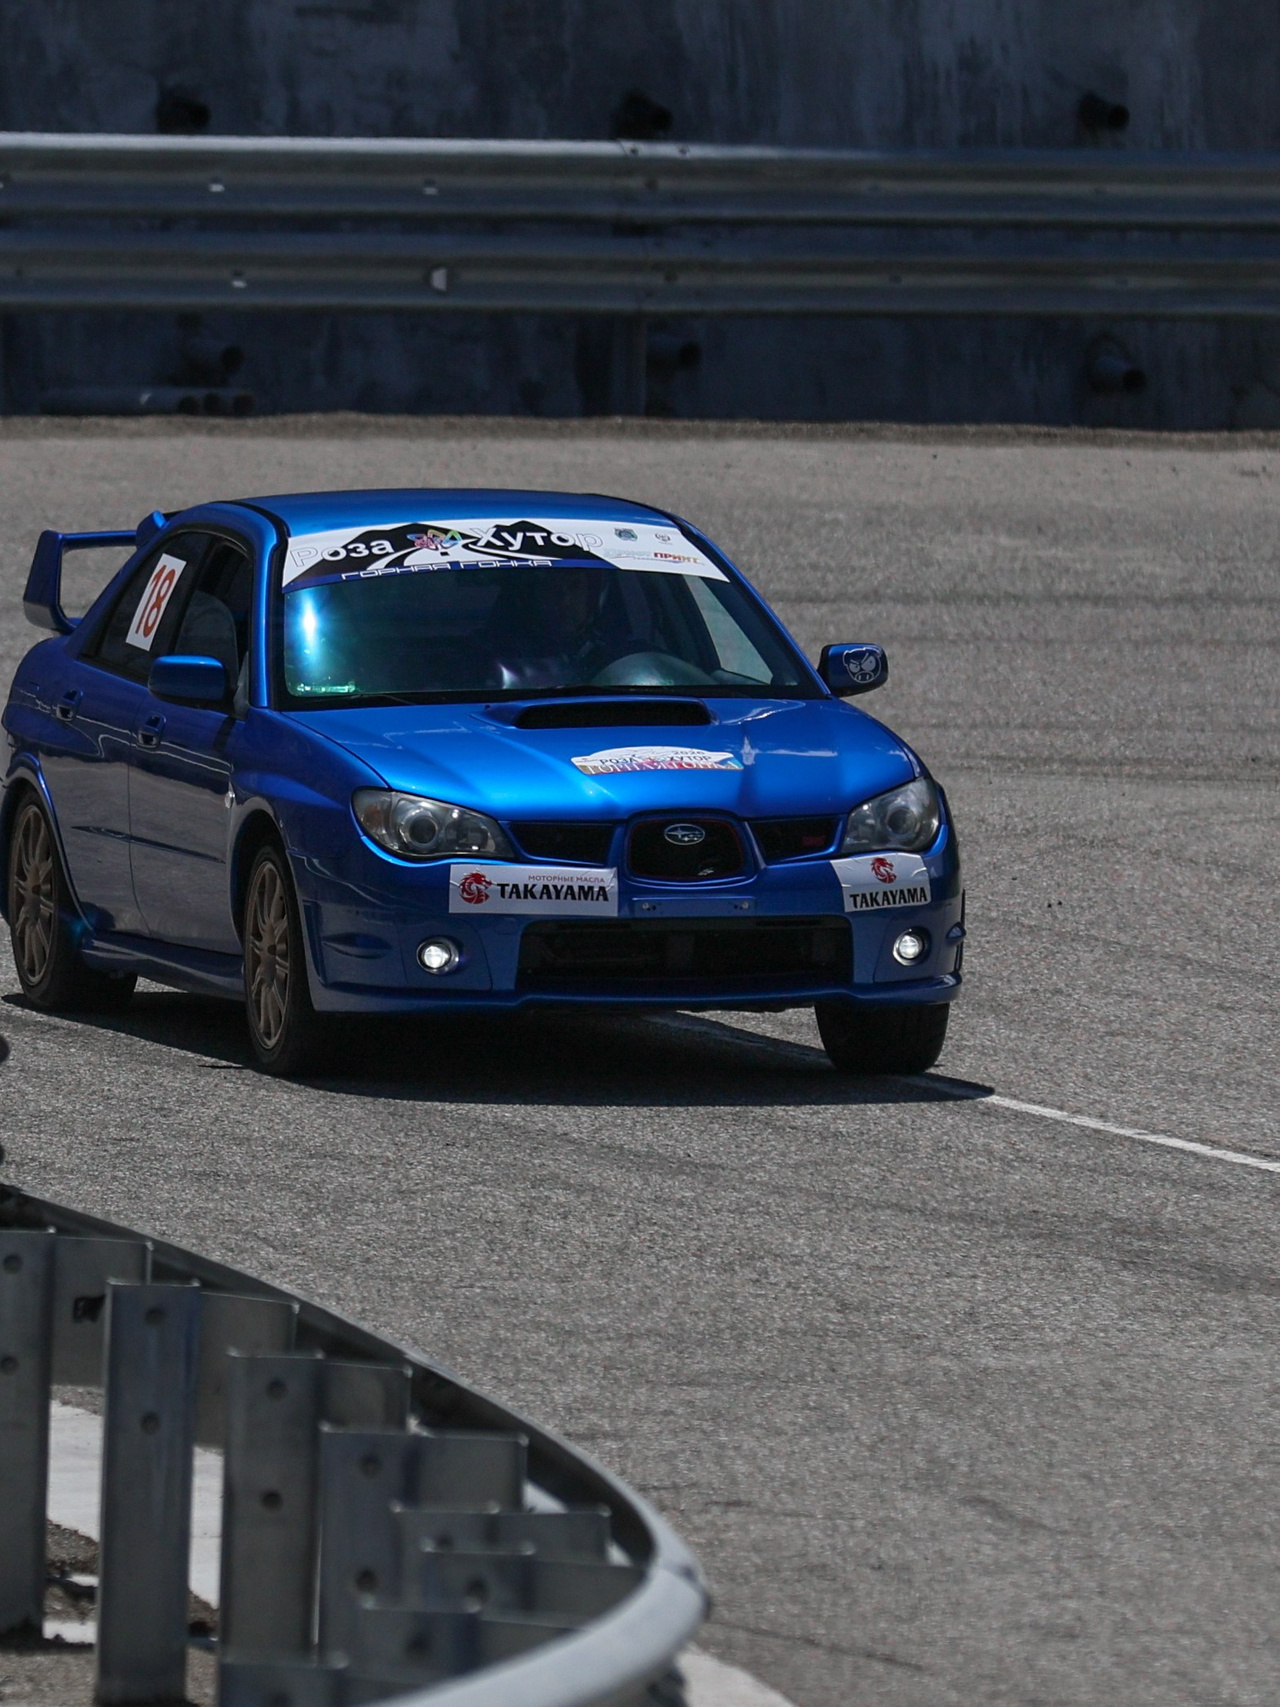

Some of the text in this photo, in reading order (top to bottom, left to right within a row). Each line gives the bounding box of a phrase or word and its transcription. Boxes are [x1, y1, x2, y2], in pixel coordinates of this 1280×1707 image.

[290, 527, 603, 567] Роза Хутор
[340, 560, 553, 580] ГОРНАЯ ГОНКА
[135, 564, 176, 638] 18
[497, 883, 610, 902] TAKAYAMA
[850, 886, 928, 909] TAKAYAMA
